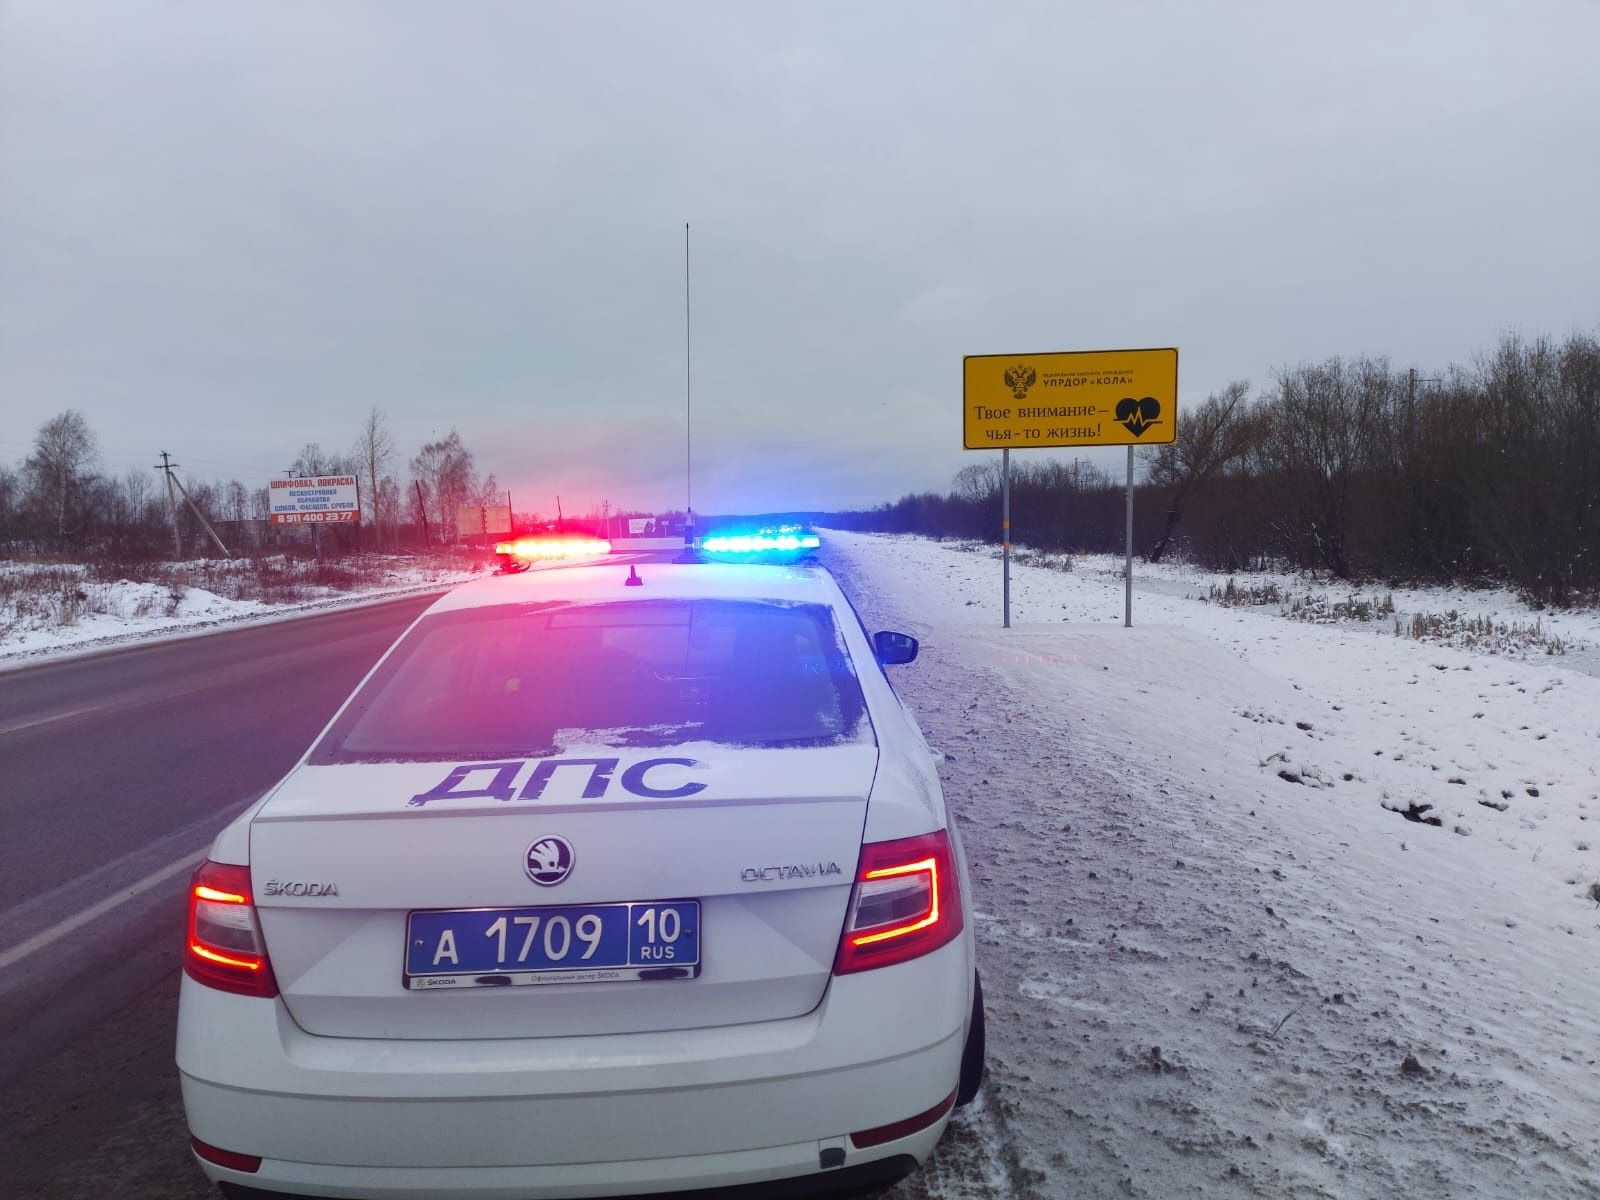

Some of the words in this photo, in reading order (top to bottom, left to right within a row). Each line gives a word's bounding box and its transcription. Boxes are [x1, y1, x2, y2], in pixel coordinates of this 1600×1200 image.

[1043, 378, 1087, 387] УПРДОР
[1090, 376, 1133, 385] «КОЛА»
[974, 406, 1011, 420] Твое
[1047, 423, 1101, 439] жизнь!
[318, 477, 354, 486] ПОКРАСКА
[286, 514, 301, 522] 911
[303, 513, 324, 522] 400
[325, 512, 339, 520] 23
[340, 512, 353, 520] 77
[404, 757, 709, 808] ДПС
[741, 862, 841, 882] OCTAVIA
[264, 879, 339, 897] ŠKODA
[485, 914, 602, 963] 1709
[637, 908, 681, 944] 10
[640, 946, 675, 961] RUS
